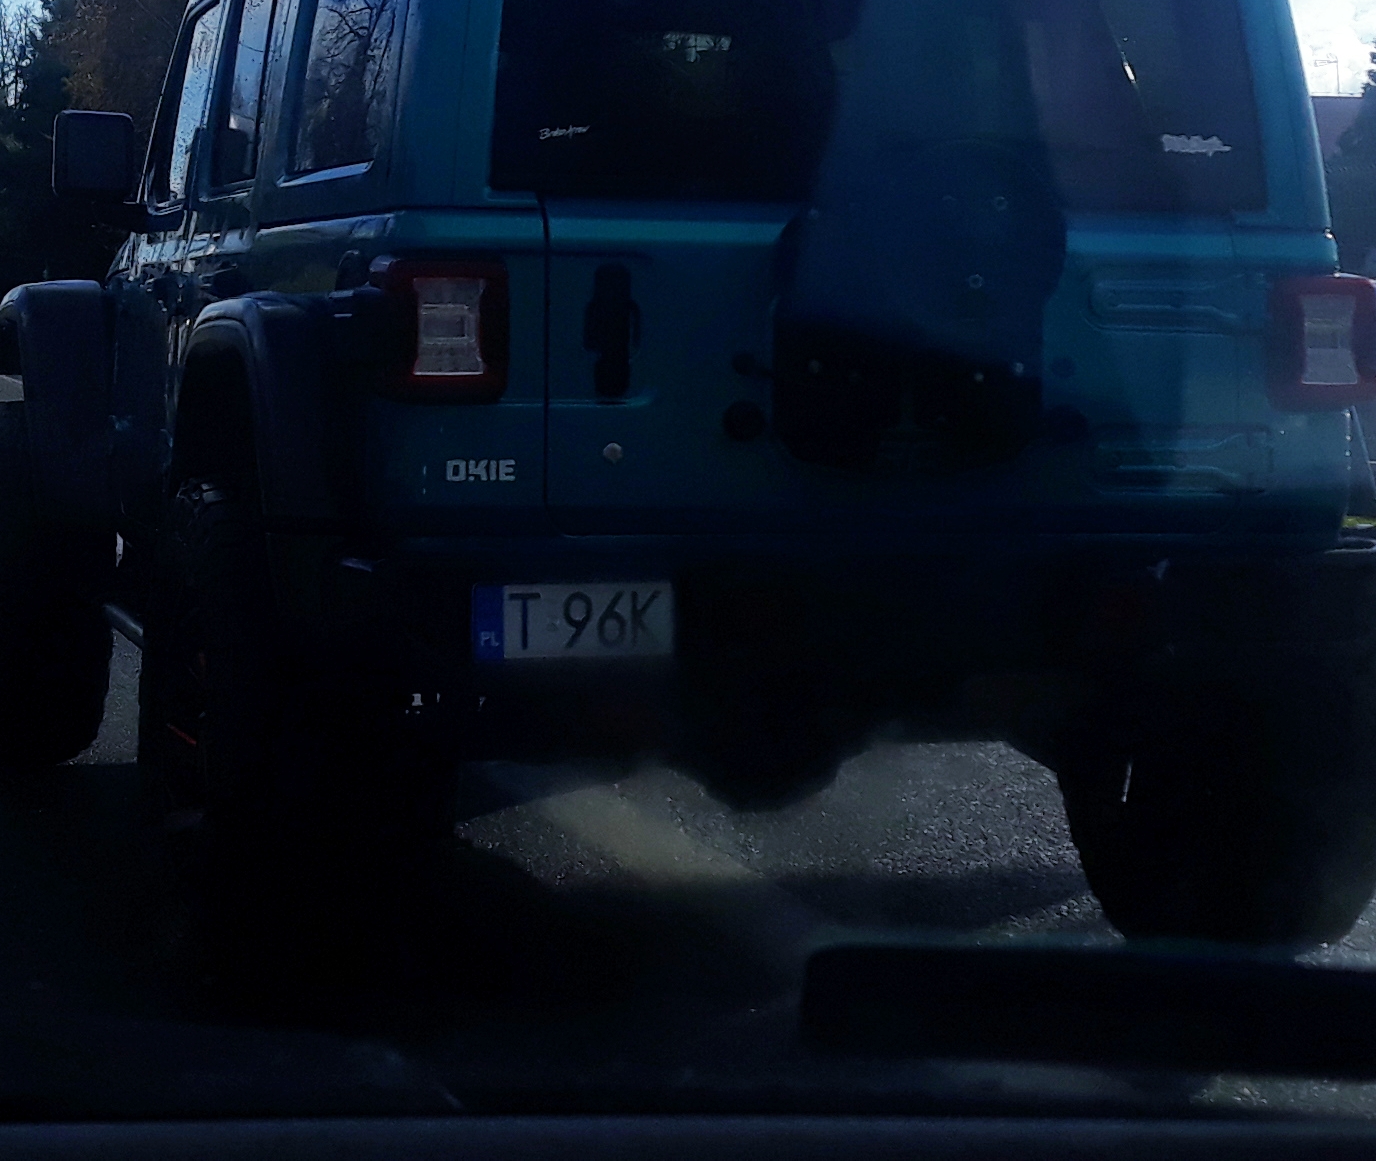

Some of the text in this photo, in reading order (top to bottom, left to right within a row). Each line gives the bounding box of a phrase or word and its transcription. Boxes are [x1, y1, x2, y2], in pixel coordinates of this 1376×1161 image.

[445, 459, 516, 482] OKIE
[507, 590, 662, 650] T 96K
